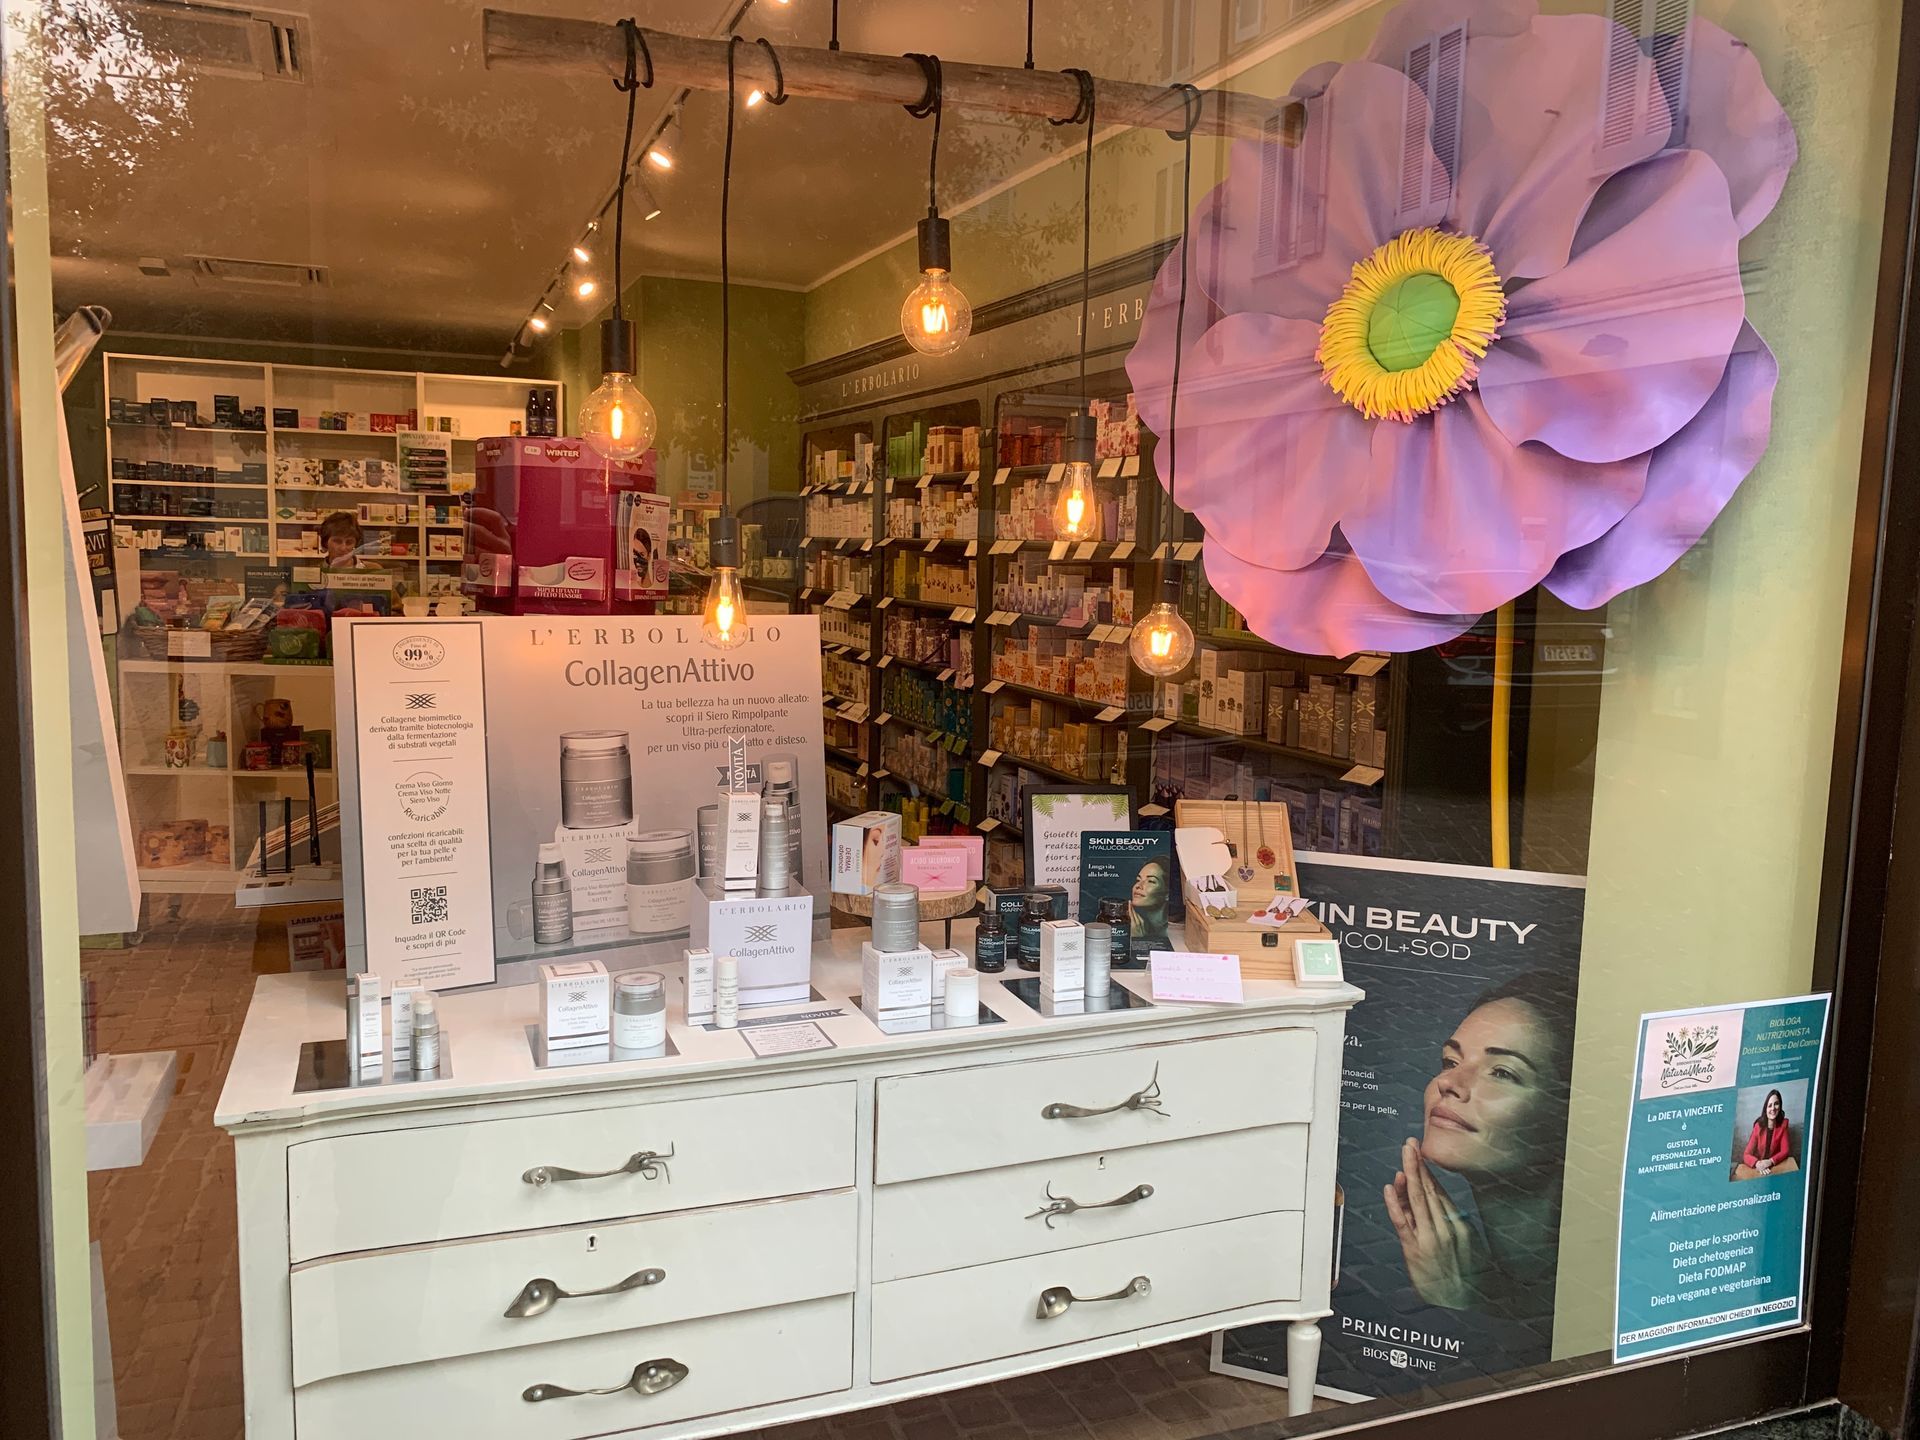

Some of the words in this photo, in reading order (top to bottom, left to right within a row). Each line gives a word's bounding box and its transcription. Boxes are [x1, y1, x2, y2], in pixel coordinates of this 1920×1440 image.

[842, 363, 920, 398] L'ERBOLARIO
[546, 449, 580, 458] WINTER
[530, 626, 781, 646] L'ERBOLIO
[565, 657, 754, 691] CollagenAttivo
[642, 700, 653, 710] La
[656, 700, 672, 709] tua
[676, 697, 714, 708] bellezza
[717, 696, 729, 706] ha
[732, 698, 744, 706] un
[748, 696, 775, 706] nuovo
[778, 694, 810, 704] alleato:
[381, 716, 416, 724] Collagene
[418, 714, 462, 722] biomimetico
[666, 712, 694, 724] scopri
[697, 712, 703, 722] il
[706, 710, 729, 720] Siero
[732, 708, 789, 720] Rimpolpante
[369, 724, 398, 733] derivato
[400, 724, 424, 732] tramite
[426, 722, 474, 731] biotecnologia
[682, 724, 775, 737] Ultra-perfezionatore,
[386, 733, 404, 741] dalla
[406, 731, 457, 740] fermentazione
[388, 742, 396, 750] di
[397, 741, 427, 749] substrati
[429, 740, 456, 748] vegetali
[647, 744, 662, 754] per
[666, 743, 679, 752] un
[682, 741, 700, 751] viso
[704, 739, 719, 752] più
[766, 738, 772, 746] e
[775, 736, 808, 746] disteso.
[732, 748, 744, 788] NOVITÀ
[395, 782, 416, 790] Crema
[398, 790, 418, 798] Crema
[410, 796, 426, 804] Siero
[404, 805, 448, 822] Ricaricabili
[388, 832, 424, 841] confezioni
[426, 828, 464, 838] ricaricabili:
[562, 830, 634, 842] L'ERBOLARIO
[1044, 830, 1078, 840] Gioielli
[390, 842, 404, 850] una
[406, 840, 428, 849] scelta
[429, 838, 436, 847] di
[438, 837, 463, 848] qualità
[397, 852, 410, 860] per
[420, 848, 432, 856] tua
[433, 846, 450, 856] pelle
[844, 847, 852, 872] DERMAL
[1046, 854, 1068, 862] fiori
[402, 859, 412, 867] per
[415, 854, 454, 865] l'ambiente!
[572, 865, 626, 878] CollagenAttivo
[719, 902, 806, 916] L'ERBOLARIO
[1306, 901, 1355, 926] IN
[1366, 907, 1538, 944] BEAUTY
[394, 933, 426, 944] Inquadra
[435, 930, 446, 938] QR
[448, 928, 466, 936] Code
[412, 941, 434, 950] scopri
[444, 938, 456, 948] più
[729, 946, 795, 959] CollagenAttivo
[550, 978, 606, 989] L'ERBOLARIO
[558, 1002, 598, 1014] CollagenAttivo
[1770, 1016, 1801, 1028] BIOLOGA
[1756, 1028, 1810, 1041] NUTRIZIONISTA
[1770, 1043, 1787, 1052] Alice
[1788, 1040, 1799, 1049] Del
[1660, 1062, 1716, 1081] NaturalMente
[1362, 1082, 1378, 1090] con
[1352, 1102, 1366, 1110] per
[1368, 1104, 1376, 1112] la
[1377, 1106, 1399, 1116] pelle.
[1648, 1114, 1656, 1122] La
[1658, 1110, 1682, 1121] DIETA
[1684, 1104, 1724, 1118] VINCENTE
[1666, 1138, 1698, 1150] GUSTOSA
[1652, 1147, 1711, 1162] PERSONALIZZATA
[1638, 1161, 1684, 1174] MANTENIBILE
[1684, 1160, 1698, 1168] NEL
[1698, 1156, 1722, 1166] TEMPO
[1650, 1203, 1716, 1222] Alimentazione
[1718, 1192, 1781, 1212] personalizzata
[1670, 1241, 1694, 1252] Dieta
[1696, 1238, 1710, 1250] per
[1712, 1235, 1721, 1244] lo
[1722, 1228, 1759, 1244] sportivo
[1672, 1258, 1697, 1269] Dieta
[1699, 1245, 1754, 1264] chetogenica
[1678, 1273, 1702, 1284] Dieta
[1704, 1262, 1747, 1279] FODMAP
[1650, 1296, 1676, 1308] Dieta
[1676, 1288, 1710, 1302] vegana
[1712, 1286, 1718, 1294] e
[1718, 1275, 1772, 1293] vegetariana
[1620, 1334, 1636, 1344] PER
[1638, 1325, 1675, 1340] MAGGIORI
[1676, 1314, 1728, 1332] INFORMAZIONI
[1729, 1310, 1752, 1320] CHIEDI
[1762, 1300, 1794, 1312] NEGOZIO
[1342, 1316, 1460, 1353] PRINCIPIUM
[1362, 1346, 1389, 1361] BIOS
[1409, 1358, 1437, 1372] LINE
